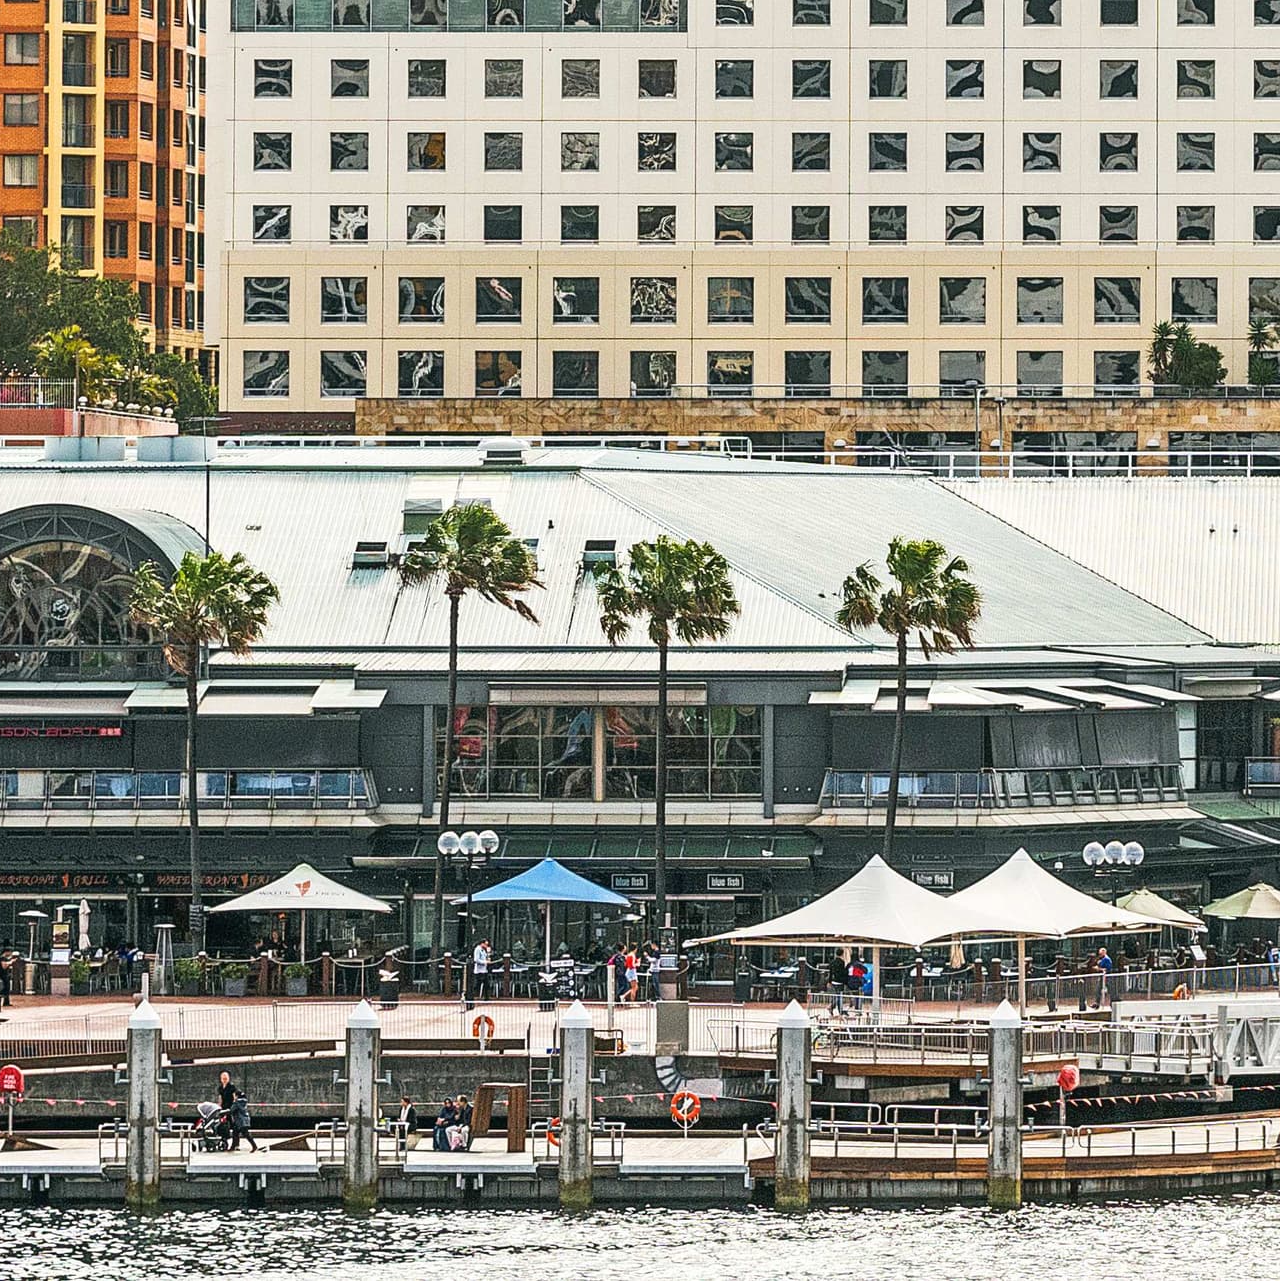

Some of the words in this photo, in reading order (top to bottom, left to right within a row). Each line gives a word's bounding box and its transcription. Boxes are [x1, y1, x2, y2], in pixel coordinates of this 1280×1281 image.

[46, 726, 97, 737] BOAT
[73, 874, 109, 886] GRILL
[615, 877, 630, 886] blue
[631, 877, 644, 886] fish
[711, 877, 726, 887] blue
[727, 877, 740, 887] fish
[934, 874, 949, 885] fish
